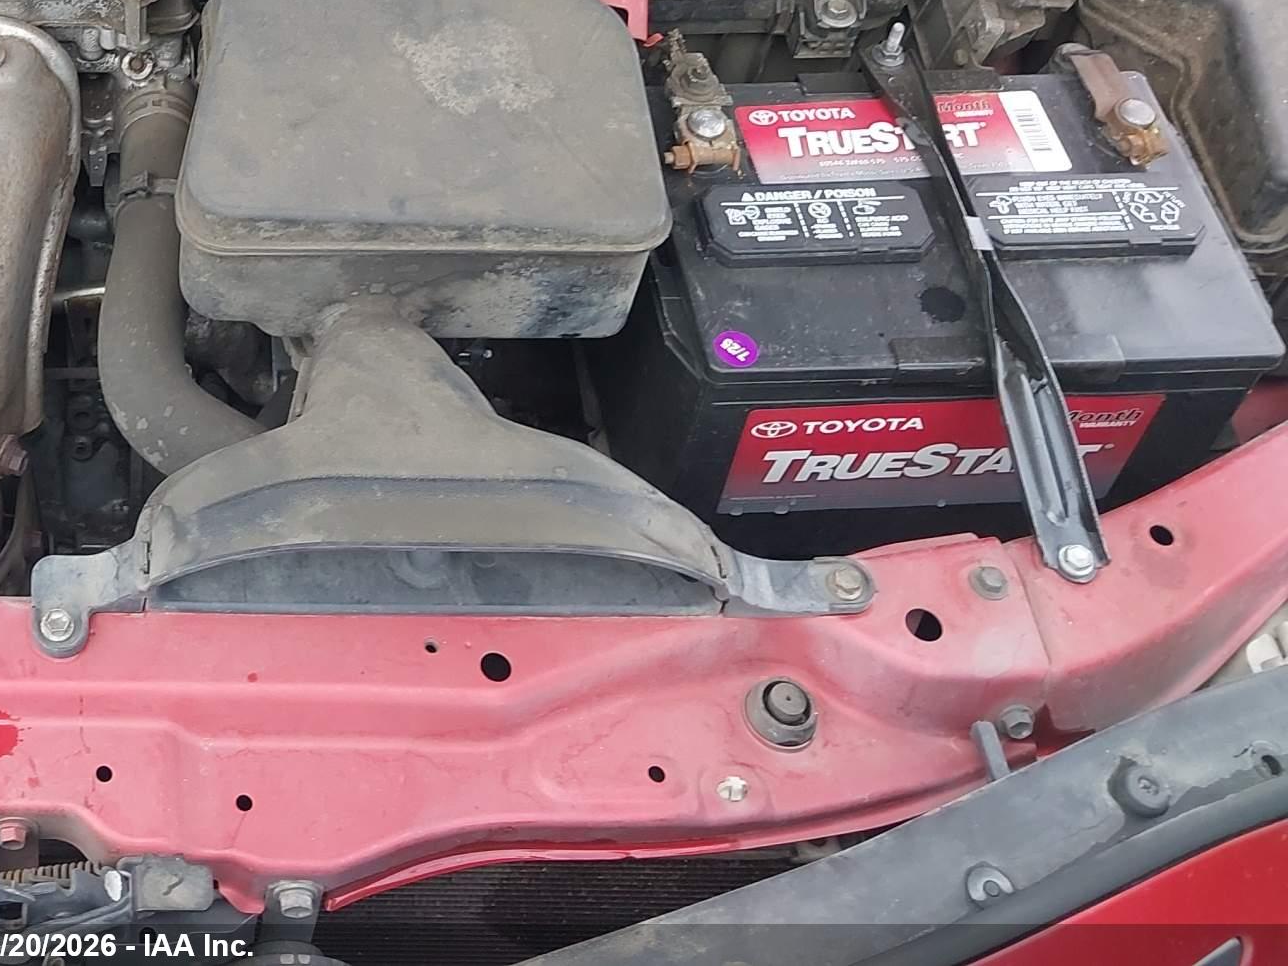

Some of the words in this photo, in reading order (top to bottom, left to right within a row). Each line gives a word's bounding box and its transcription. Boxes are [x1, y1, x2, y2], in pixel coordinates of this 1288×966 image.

[777, 106, 856, 122] TOYOTA
[778, 122, 980, 158] TRUESTRT
[754, 189, 812, 202] DANGER
[824, 187, 877, 199] POISON
[802, 417, 925, 435] TOYOTA
[761, 442, 1103, 484] TRUESTAT
